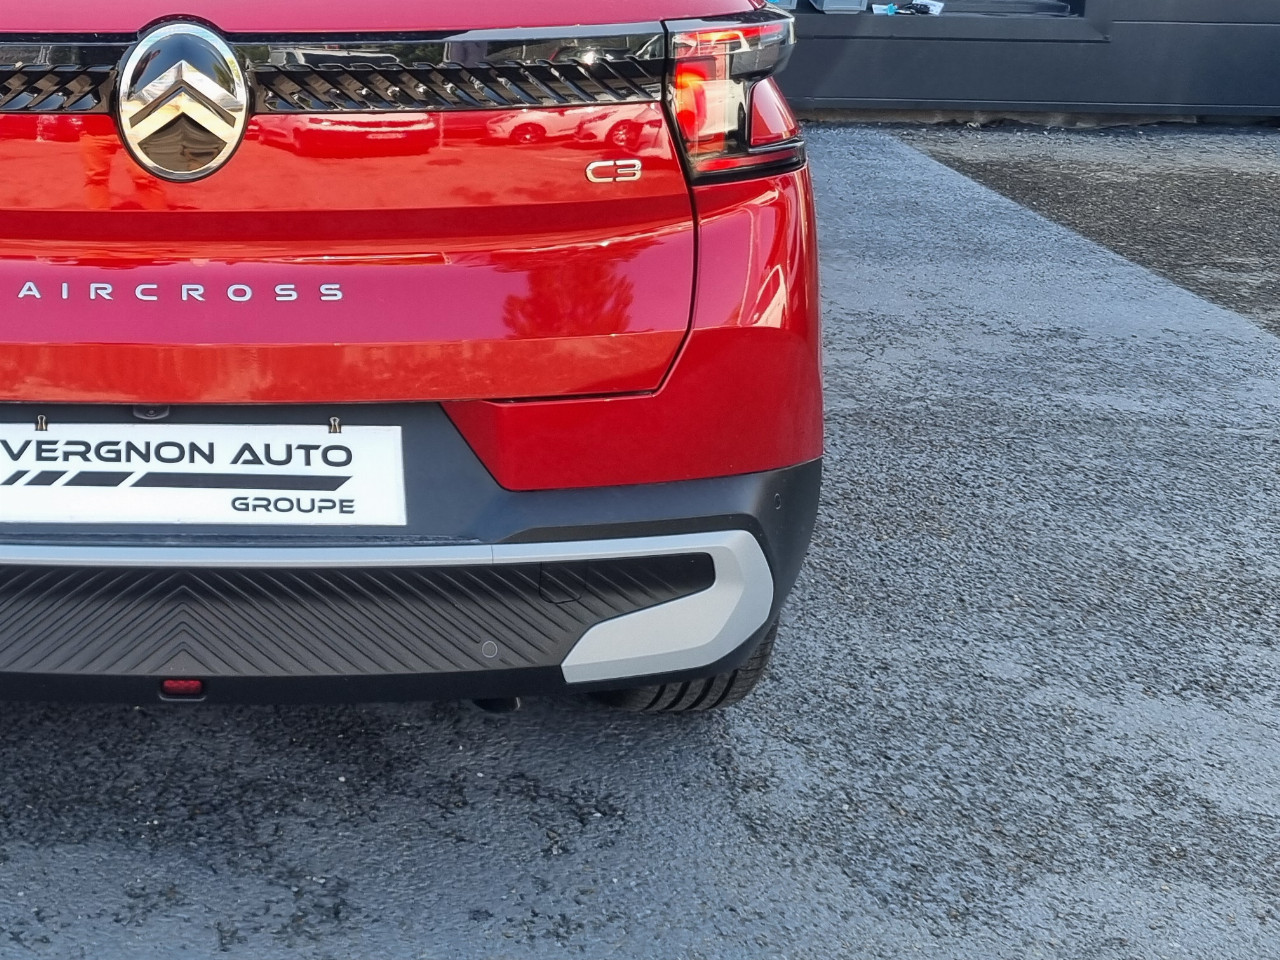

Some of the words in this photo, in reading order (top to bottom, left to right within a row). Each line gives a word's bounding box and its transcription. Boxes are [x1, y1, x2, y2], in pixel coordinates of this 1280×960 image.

[586, 159, 642, 183] C3
[17, 282, 343, 302] AIRCROSS
[0, 439, 214, 464] VERGNON
[230, 443, 353, 467] AUTO
[231, 496, 355, 514] GROUPE
